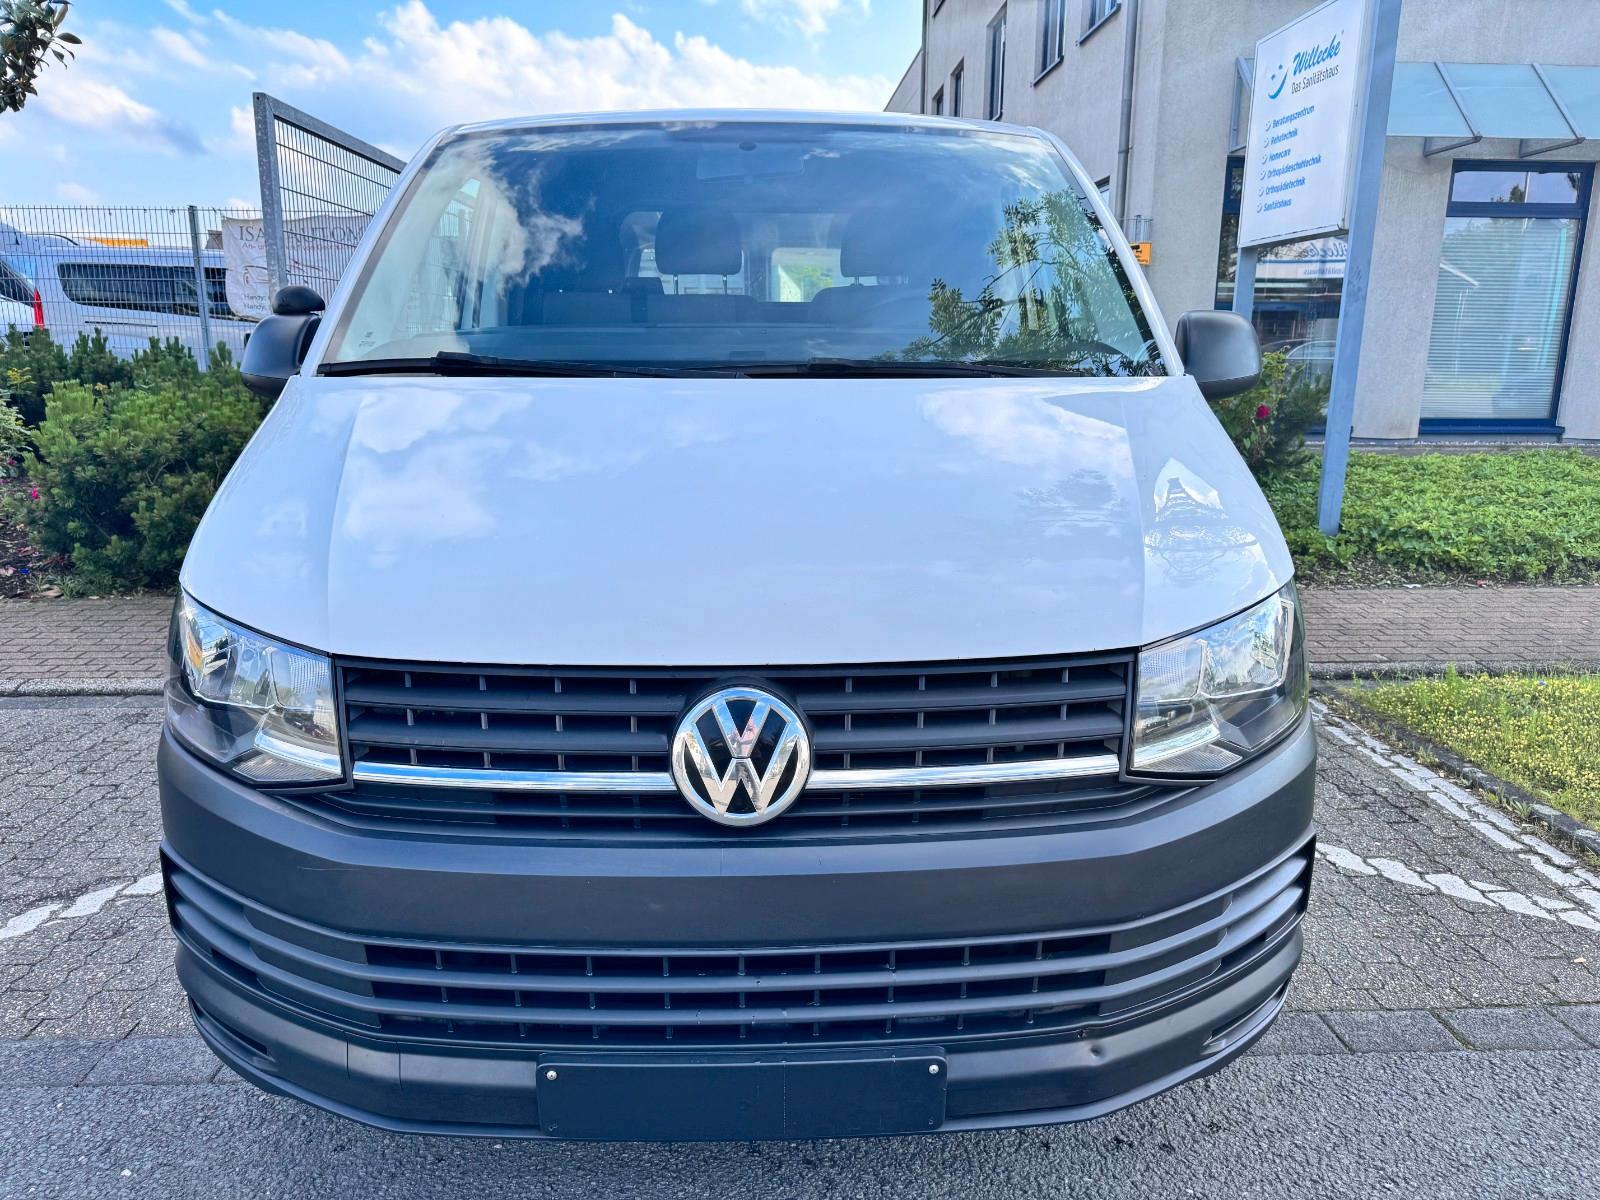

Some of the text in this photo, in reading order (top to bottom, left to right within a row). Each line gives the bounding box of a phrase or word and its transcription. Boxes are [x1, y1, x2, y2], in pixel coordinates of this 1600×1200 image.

[1292, 34, 1341, 76] Willecke
[1291, 64, 1340, 95] Das Sanitätshaus
[1272, 104, 1315, 128] Beratungszentrum
[1270, 128, 1298, 145] Rehatechnik
[1268, 148, 1291, 162] Homecare
[239, 225, 363, 245] ISA AUTOM
[674, 690, 809, 824] VW
